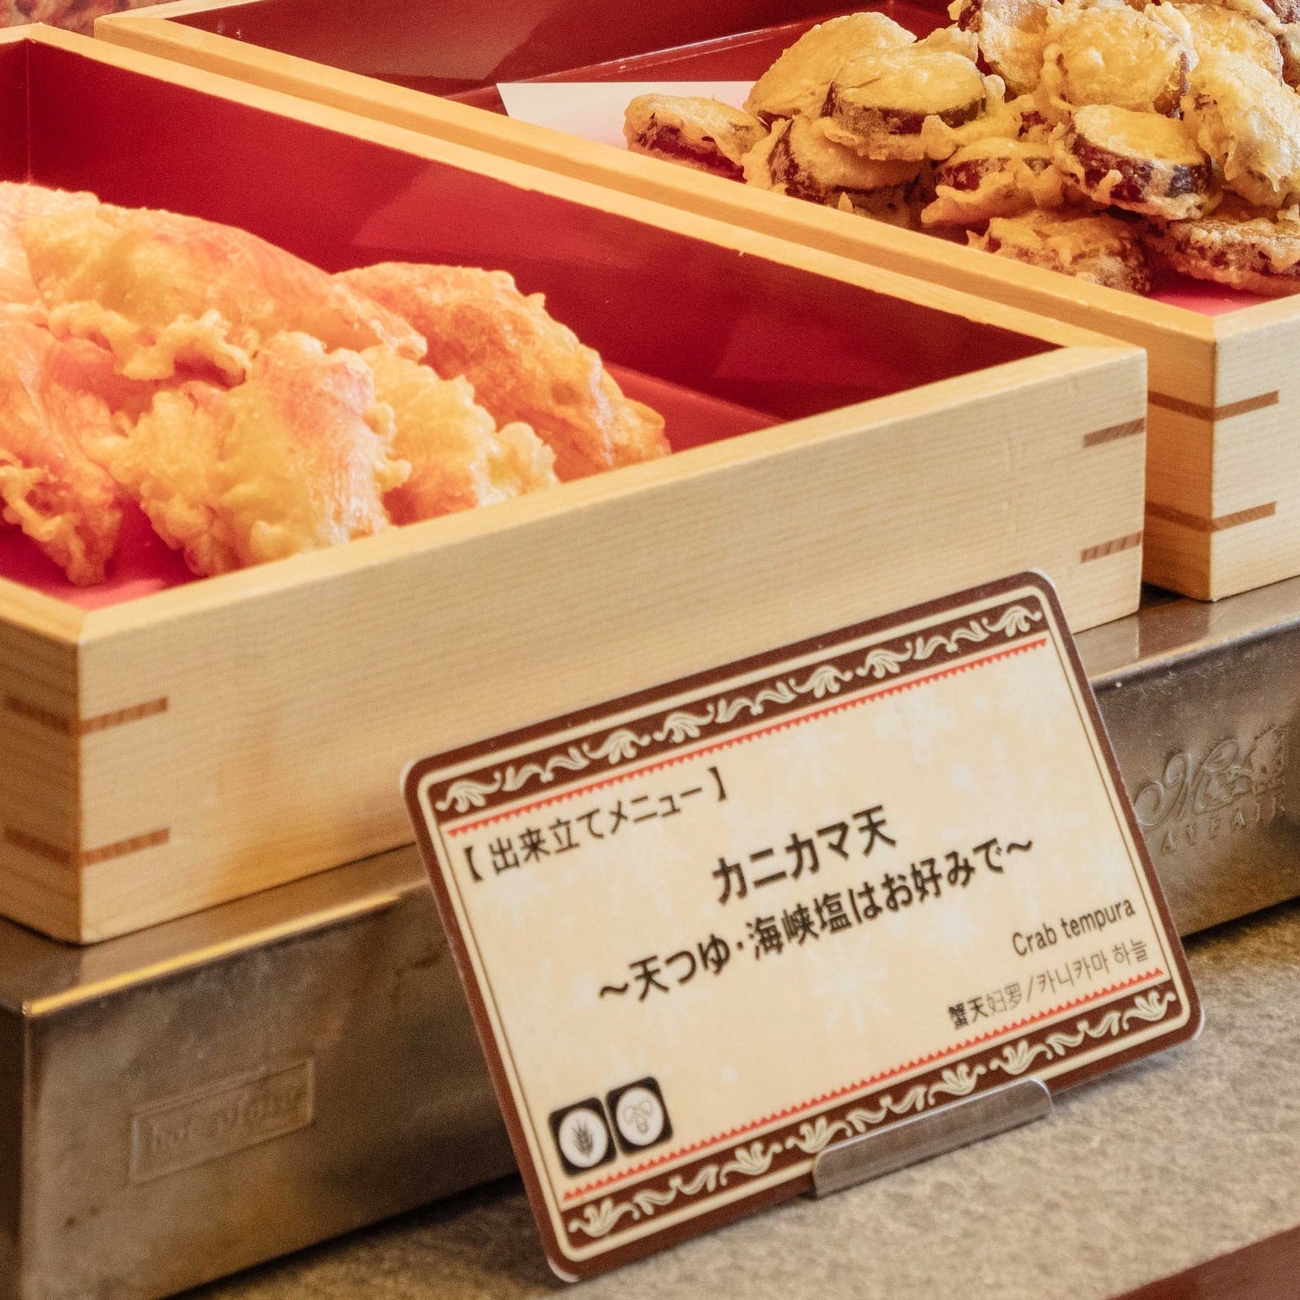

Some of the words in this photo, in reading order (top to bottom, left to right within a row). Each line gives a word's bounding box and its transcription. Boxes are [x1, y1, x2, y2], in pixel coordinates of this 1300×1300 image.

[462, 766, 729, 882] 【出来立てメニュー】
[712, 804, 897, 904] カニカマ天
[1012, 923, 1058, 957] Crab
[1061, 899, 1136, 939] tempura
[1111, 939, 1149, 963] 하늘
